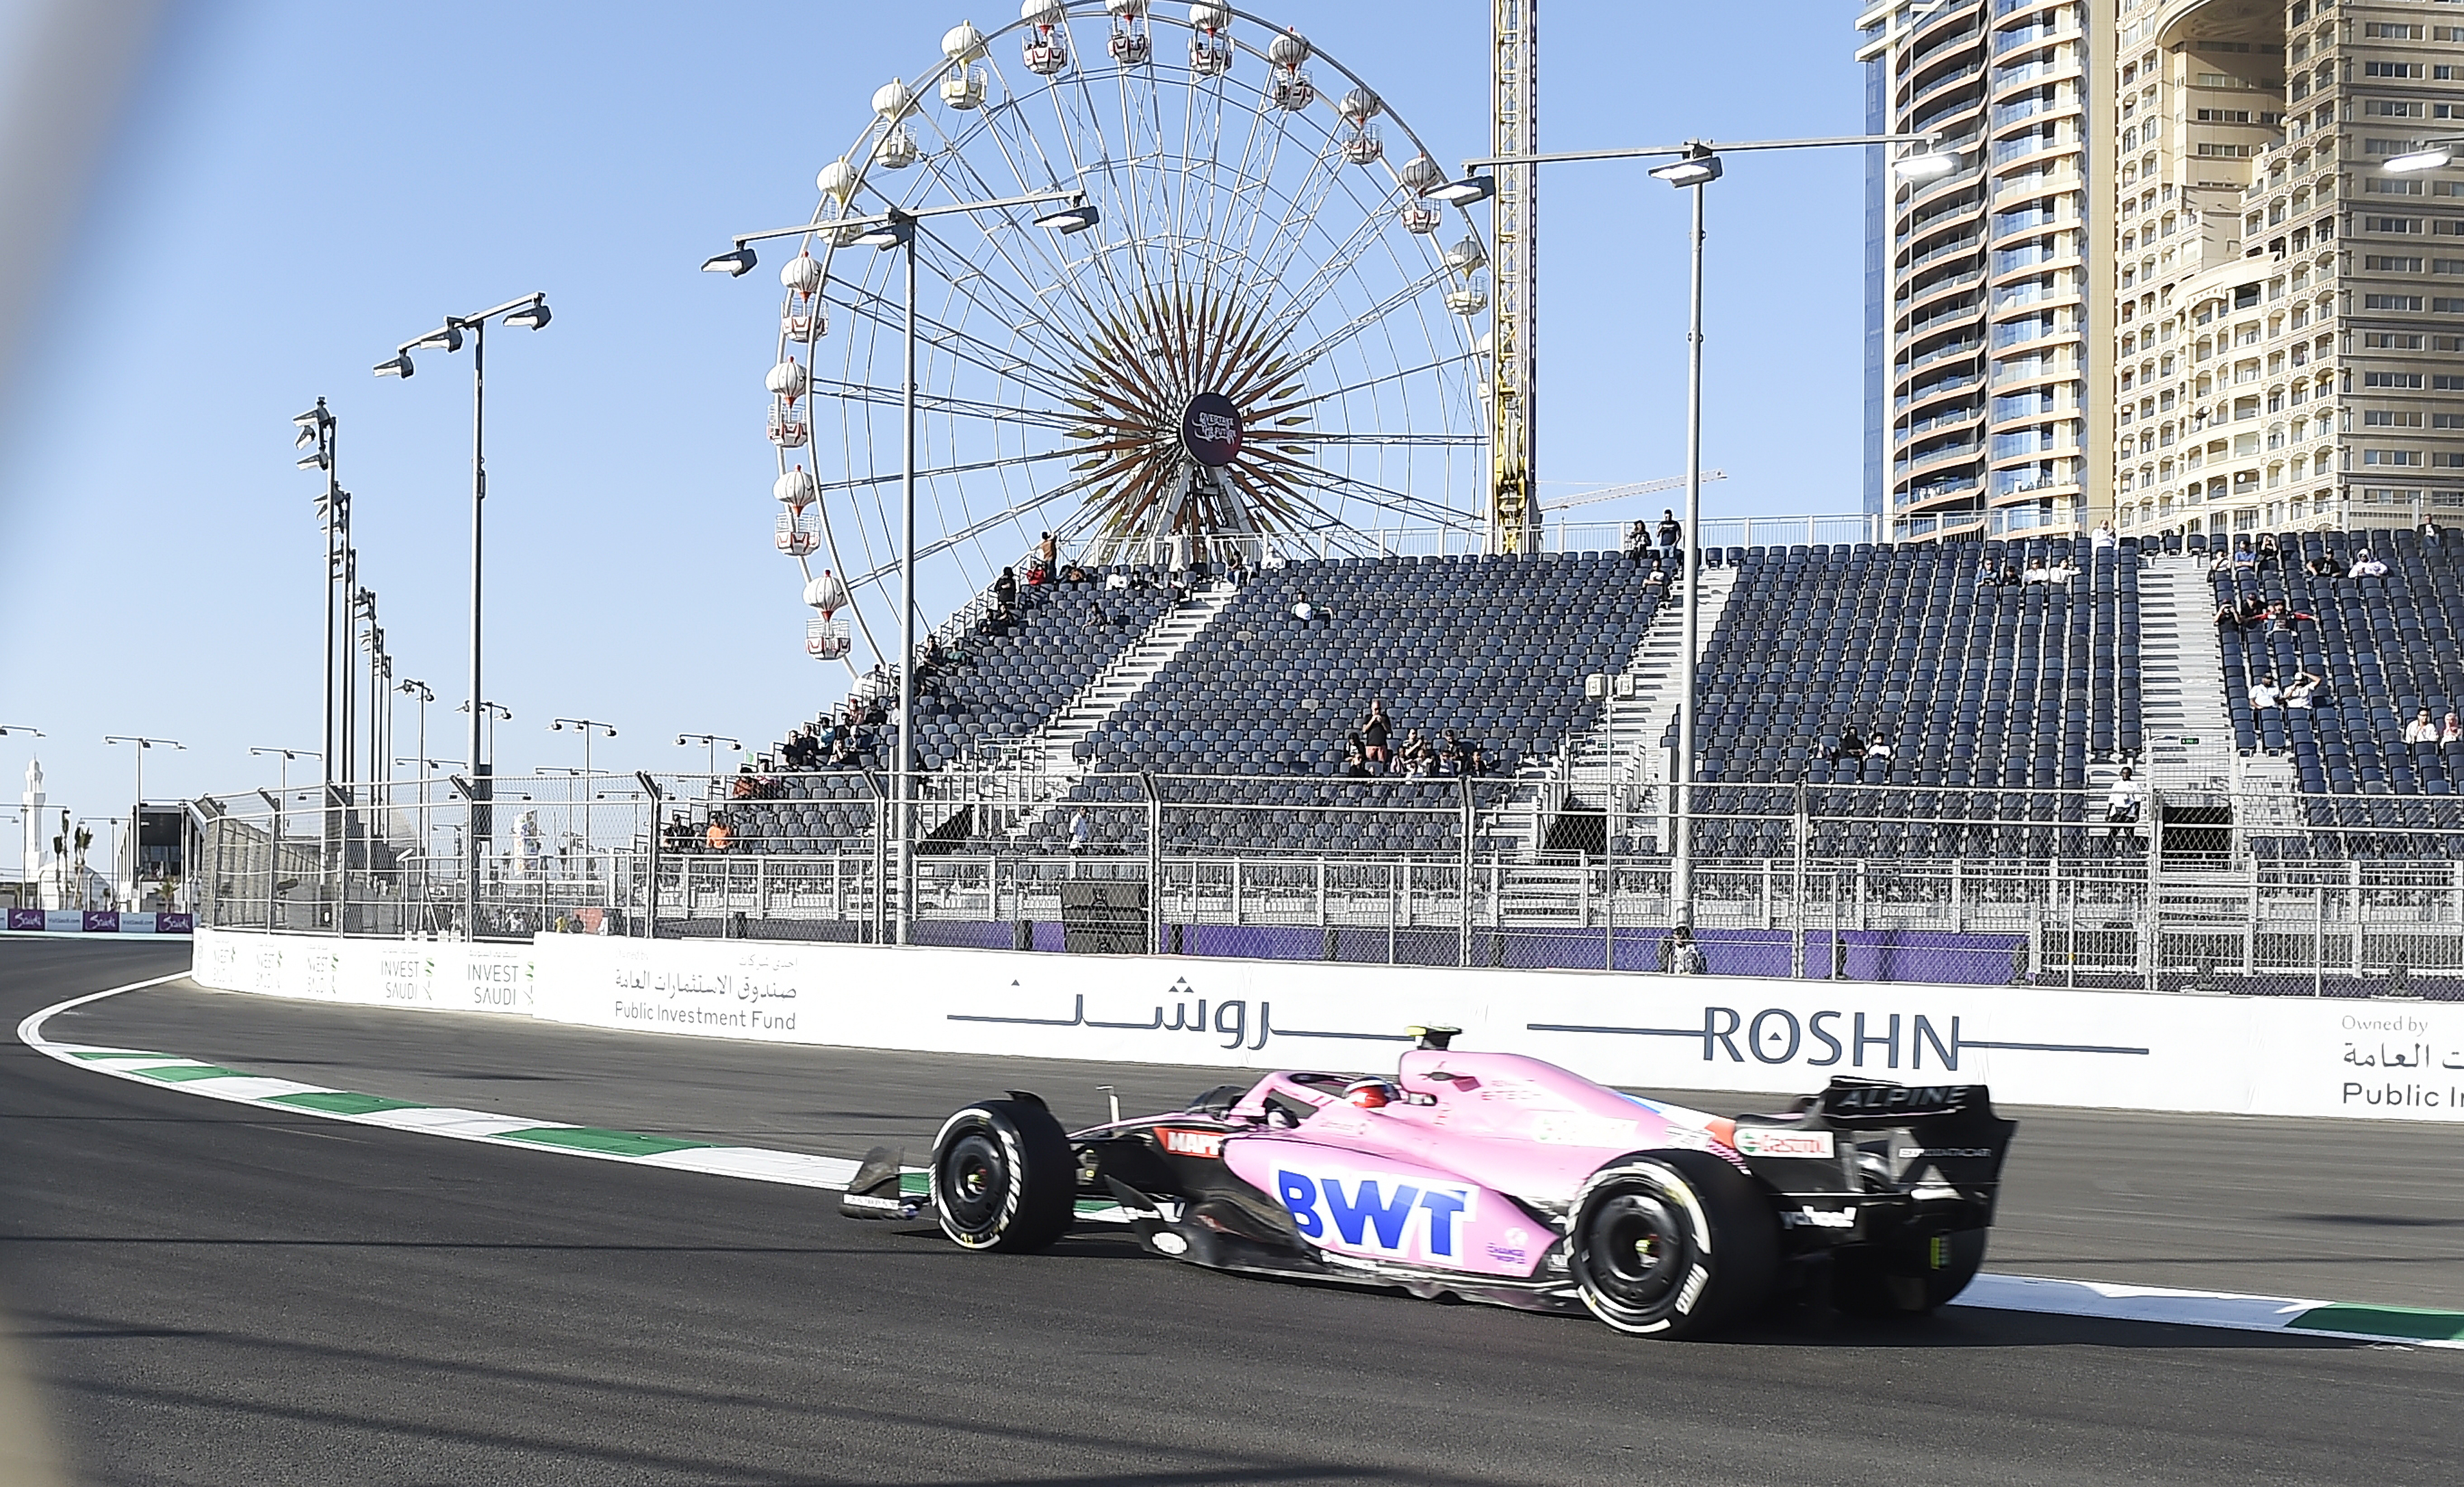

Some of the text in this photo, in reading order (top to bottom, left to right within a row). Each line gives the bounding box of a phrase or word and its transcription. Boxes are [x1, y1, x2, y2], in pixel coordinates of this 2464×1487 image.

[381, 961, 419, 977] INVEST
[468, 964, 519, 982] INVEST
[386, 982, 418, 999] SAUDI
[474, 987, 515, 1005] SAUDI
[737, 977, 796, 1003] صندوق
[615, 1001, 795, 1030] Public Investment Fund
[2342, 1016, 2428, 1037] Owned by
[1703, 1007, 1960, 1072] ROSHN
[2344, 1042, 2429, 1068] العامة
[1837, 1086, 1970, 1108] ALPINE
[2344, 1083, 2439, 1107] Public
[1279, 1169, 1468, 1256] BWT
